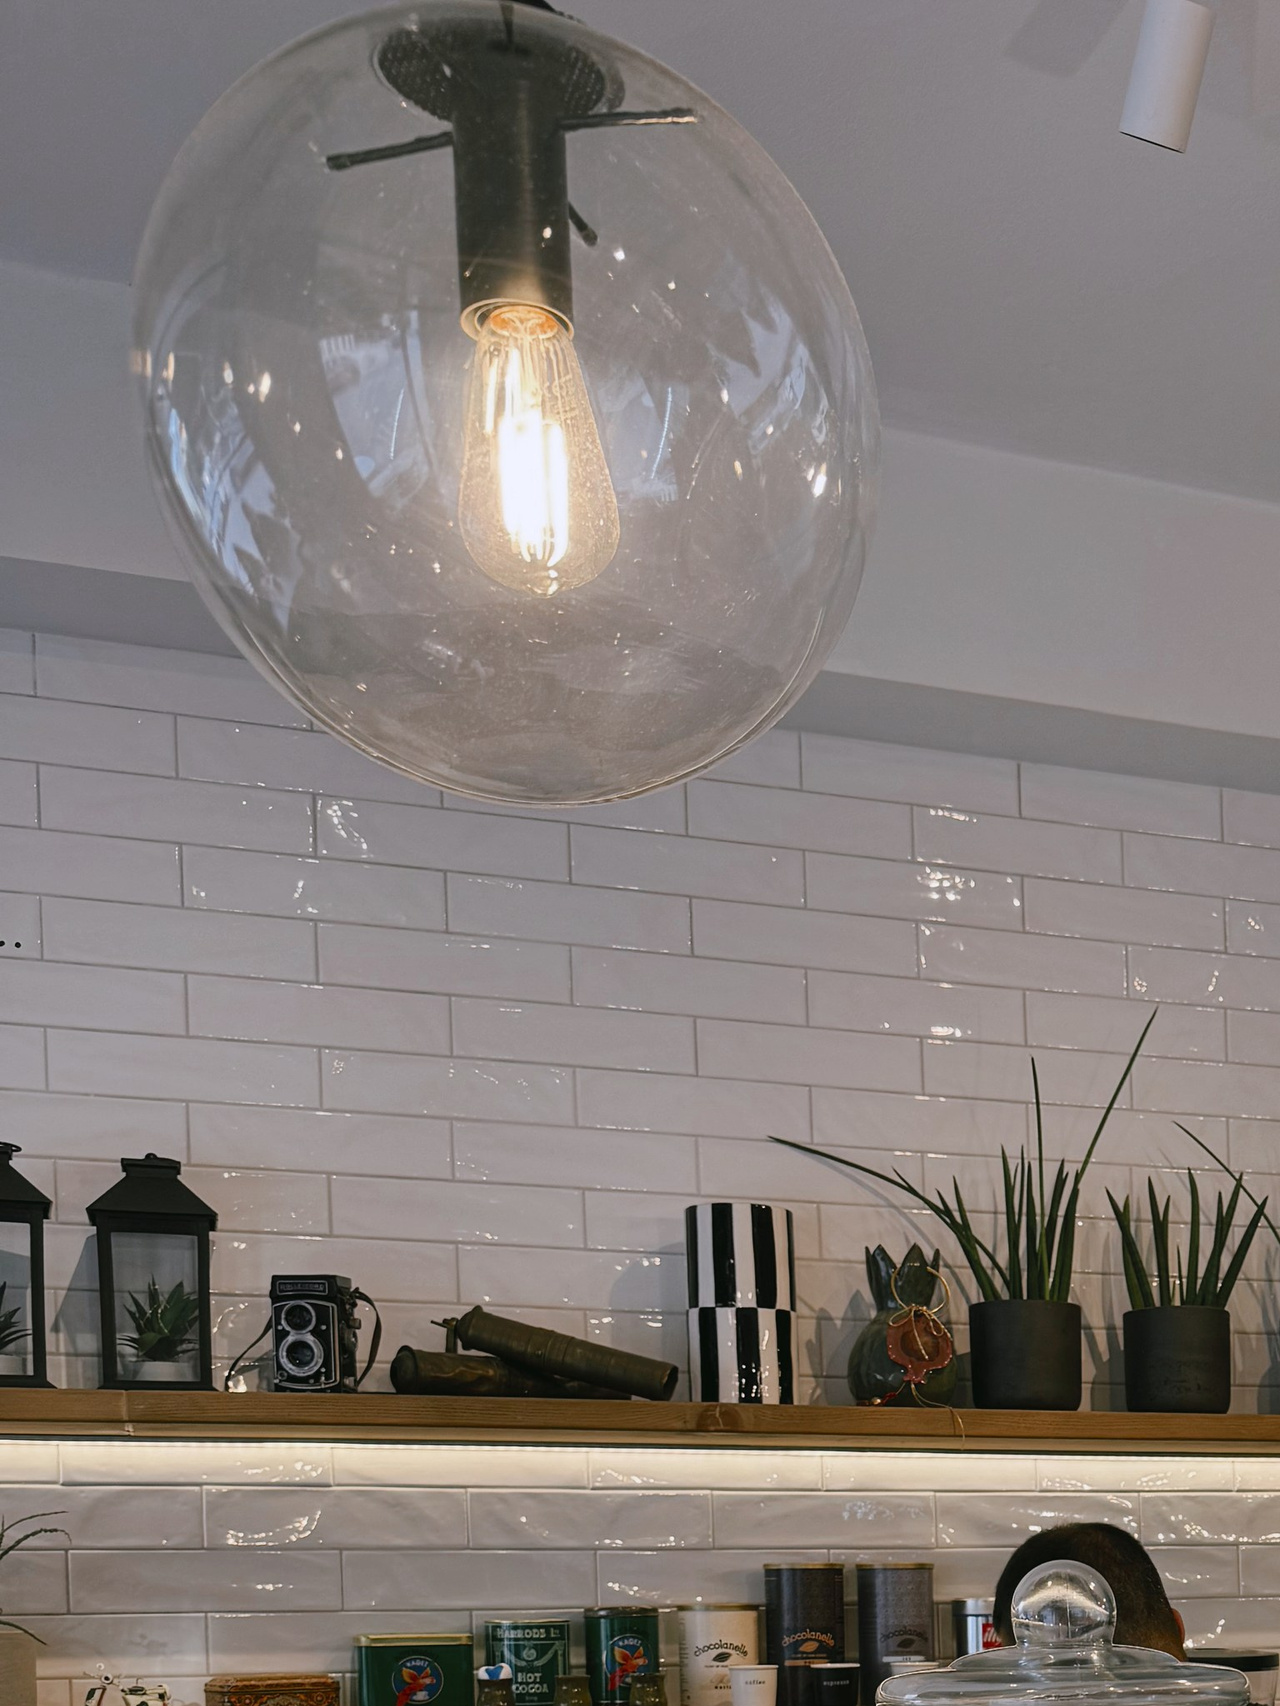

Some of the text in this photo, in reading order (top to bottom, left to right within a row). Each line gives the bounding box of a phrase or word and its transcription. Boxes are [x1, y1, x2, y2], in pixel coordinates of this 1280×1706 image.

[497, 1627, 546, 1638] HARRODS
[517, 1672, 542, 1682] HOT
[512, 1684, 548, 1693] COCOA
